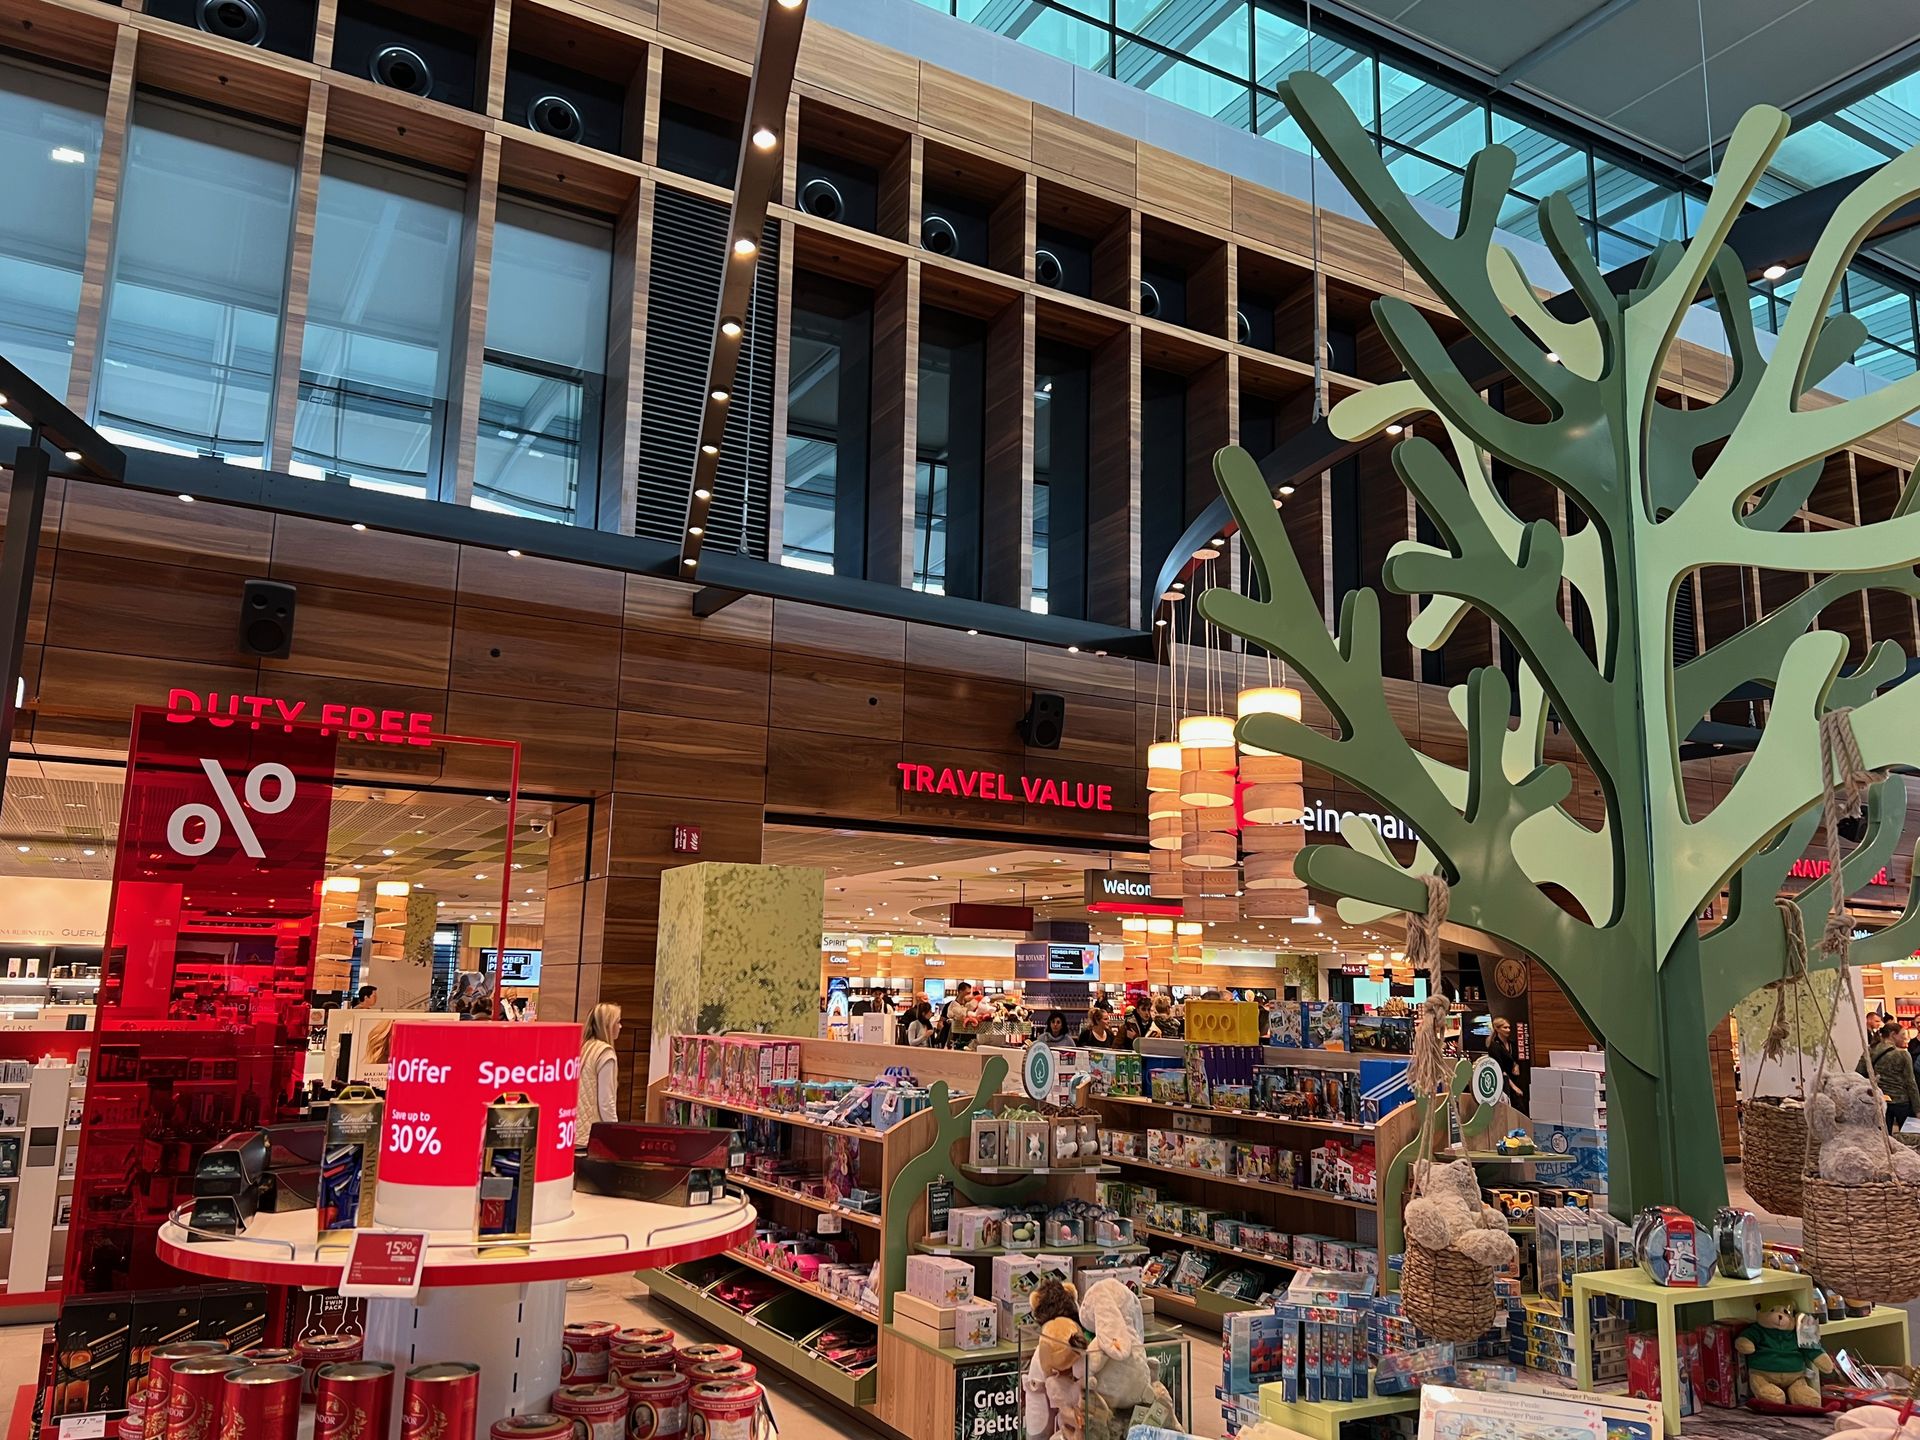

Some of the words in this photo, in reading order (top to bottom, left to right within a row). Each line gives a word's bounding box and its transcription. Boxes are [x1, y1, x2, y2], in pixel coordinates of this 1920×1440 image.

[166, 688, 306, 732] DUTY
[320, 704, 433, 746] FREE
[897, 762, 1014, 801] TRAVEL
[1021, 776, 1113, 811] VALUE
[823, 936, 846, 947] SPIRIT
[489, 956, 525, 964] MMBER
[1516, 1023, 1525, 1060] BERLIN
[398, 1058, 452, 1084] Offer
[478, 1058, 560, 1089] Special
[392, 1109, 407, 1120] Save
[407, 1112, 418, 1122] up
[420, 1112, 430, 1122] to
[389, 1123, 442, 1155] 30%
[556, 1120, 576, 1150] 30
[974, 1414, 1019, 1436] Bette
